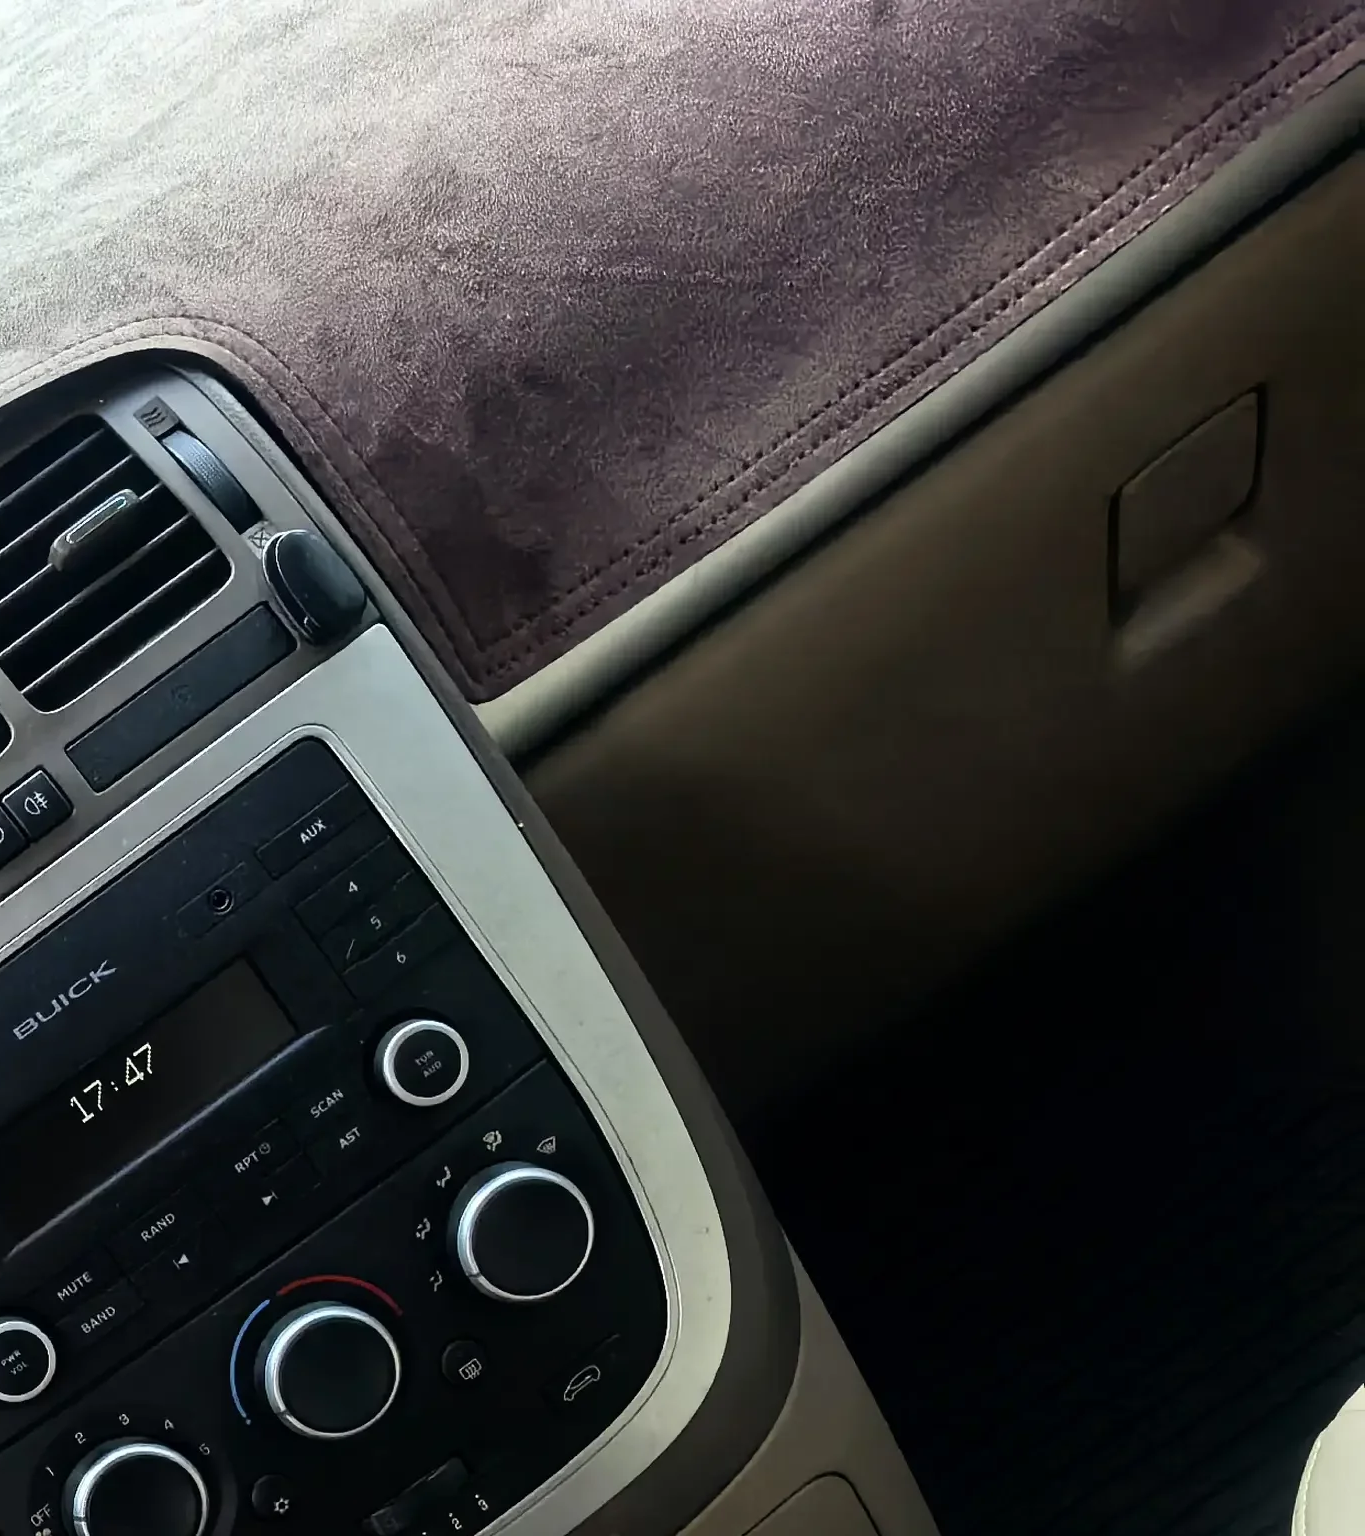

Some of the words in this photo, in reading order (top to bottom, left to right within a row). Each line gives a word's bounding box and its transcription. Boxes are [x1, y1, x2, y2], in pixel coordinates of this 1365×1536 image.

[299, 819, 327, 844] AUX
[348, 880, 359, 893] 4
[370, 915, 382, 930] 5
[396, 951, 407, 964] 6
[12, 959, 118, 1040] BUICK
[70, 1041, 153, 1124] 17:47
[310, 1089, 344, 1119] SCAN
[339, 1126, 362, 1149] AST
[234, 1151, 259, 1174] RPT
[140, 1212, 176, 1242] RAND
[57, 1271, 93, 1301] MUTE
[80, 1305, 116, 1334] BAND
[0, 1350, 21, 1367] PWR
[10, 1361, 29, 1376] VOL
[118, 1413, 130, 1426] 3
[164, 1419, 175, 1430] 4
[74, 1432, 87, 1445] 2
[199, 1443, 211, 1456] 5
[44, 1466, 55, 1477] 1
[30, 1503, 52, 1527] OFF
[451, 1517, 463, 1530] 2
[477, 1499, 489, 1512] 3
